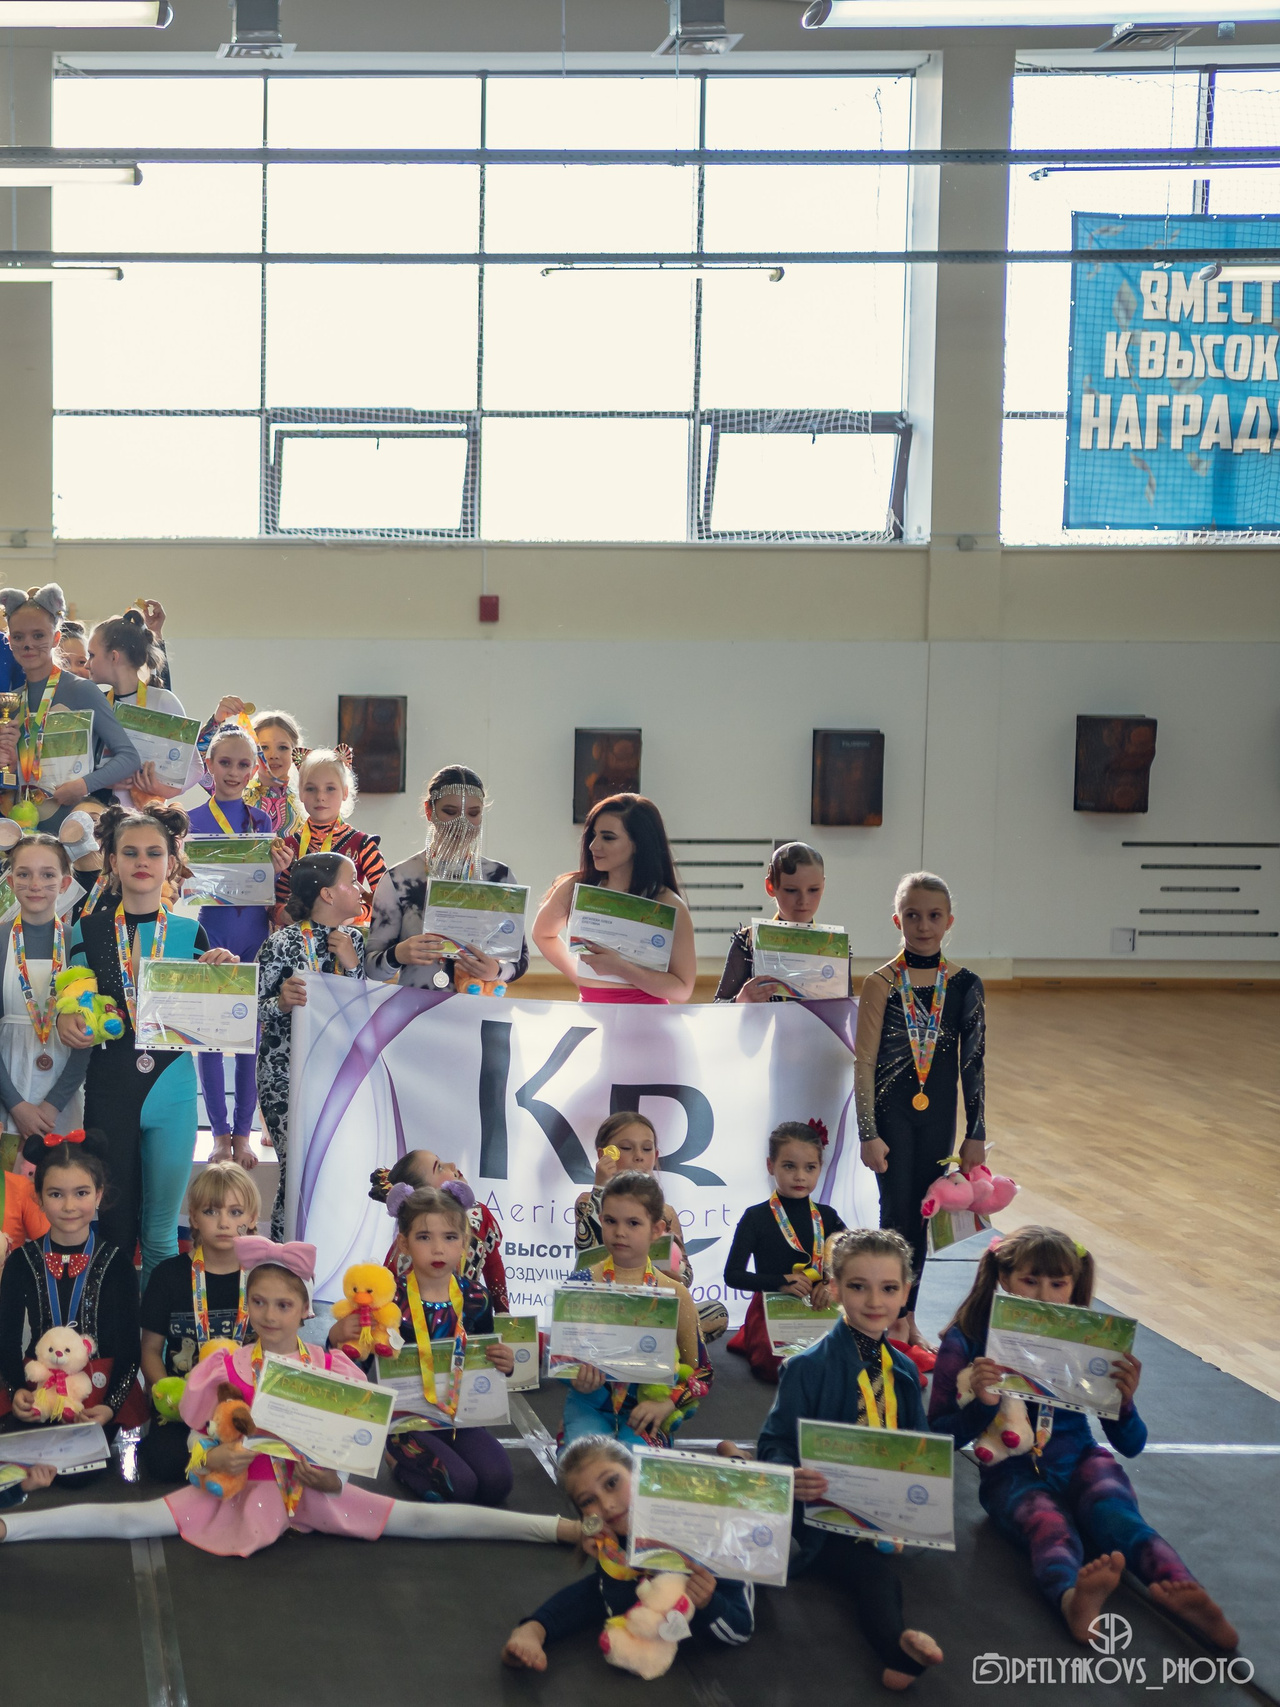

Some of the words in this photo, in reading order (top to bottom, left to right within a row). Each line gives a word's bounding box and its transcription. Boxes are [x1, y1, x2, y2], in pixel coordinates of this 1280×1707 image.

[1105, 331, 1131, 379] К
[1139, 331, 1279, 382] ВЫСОК
[1079, 393, 1280, 454] НАГРАД
[504, 1242, 577, 1259] ВЫСОТ
